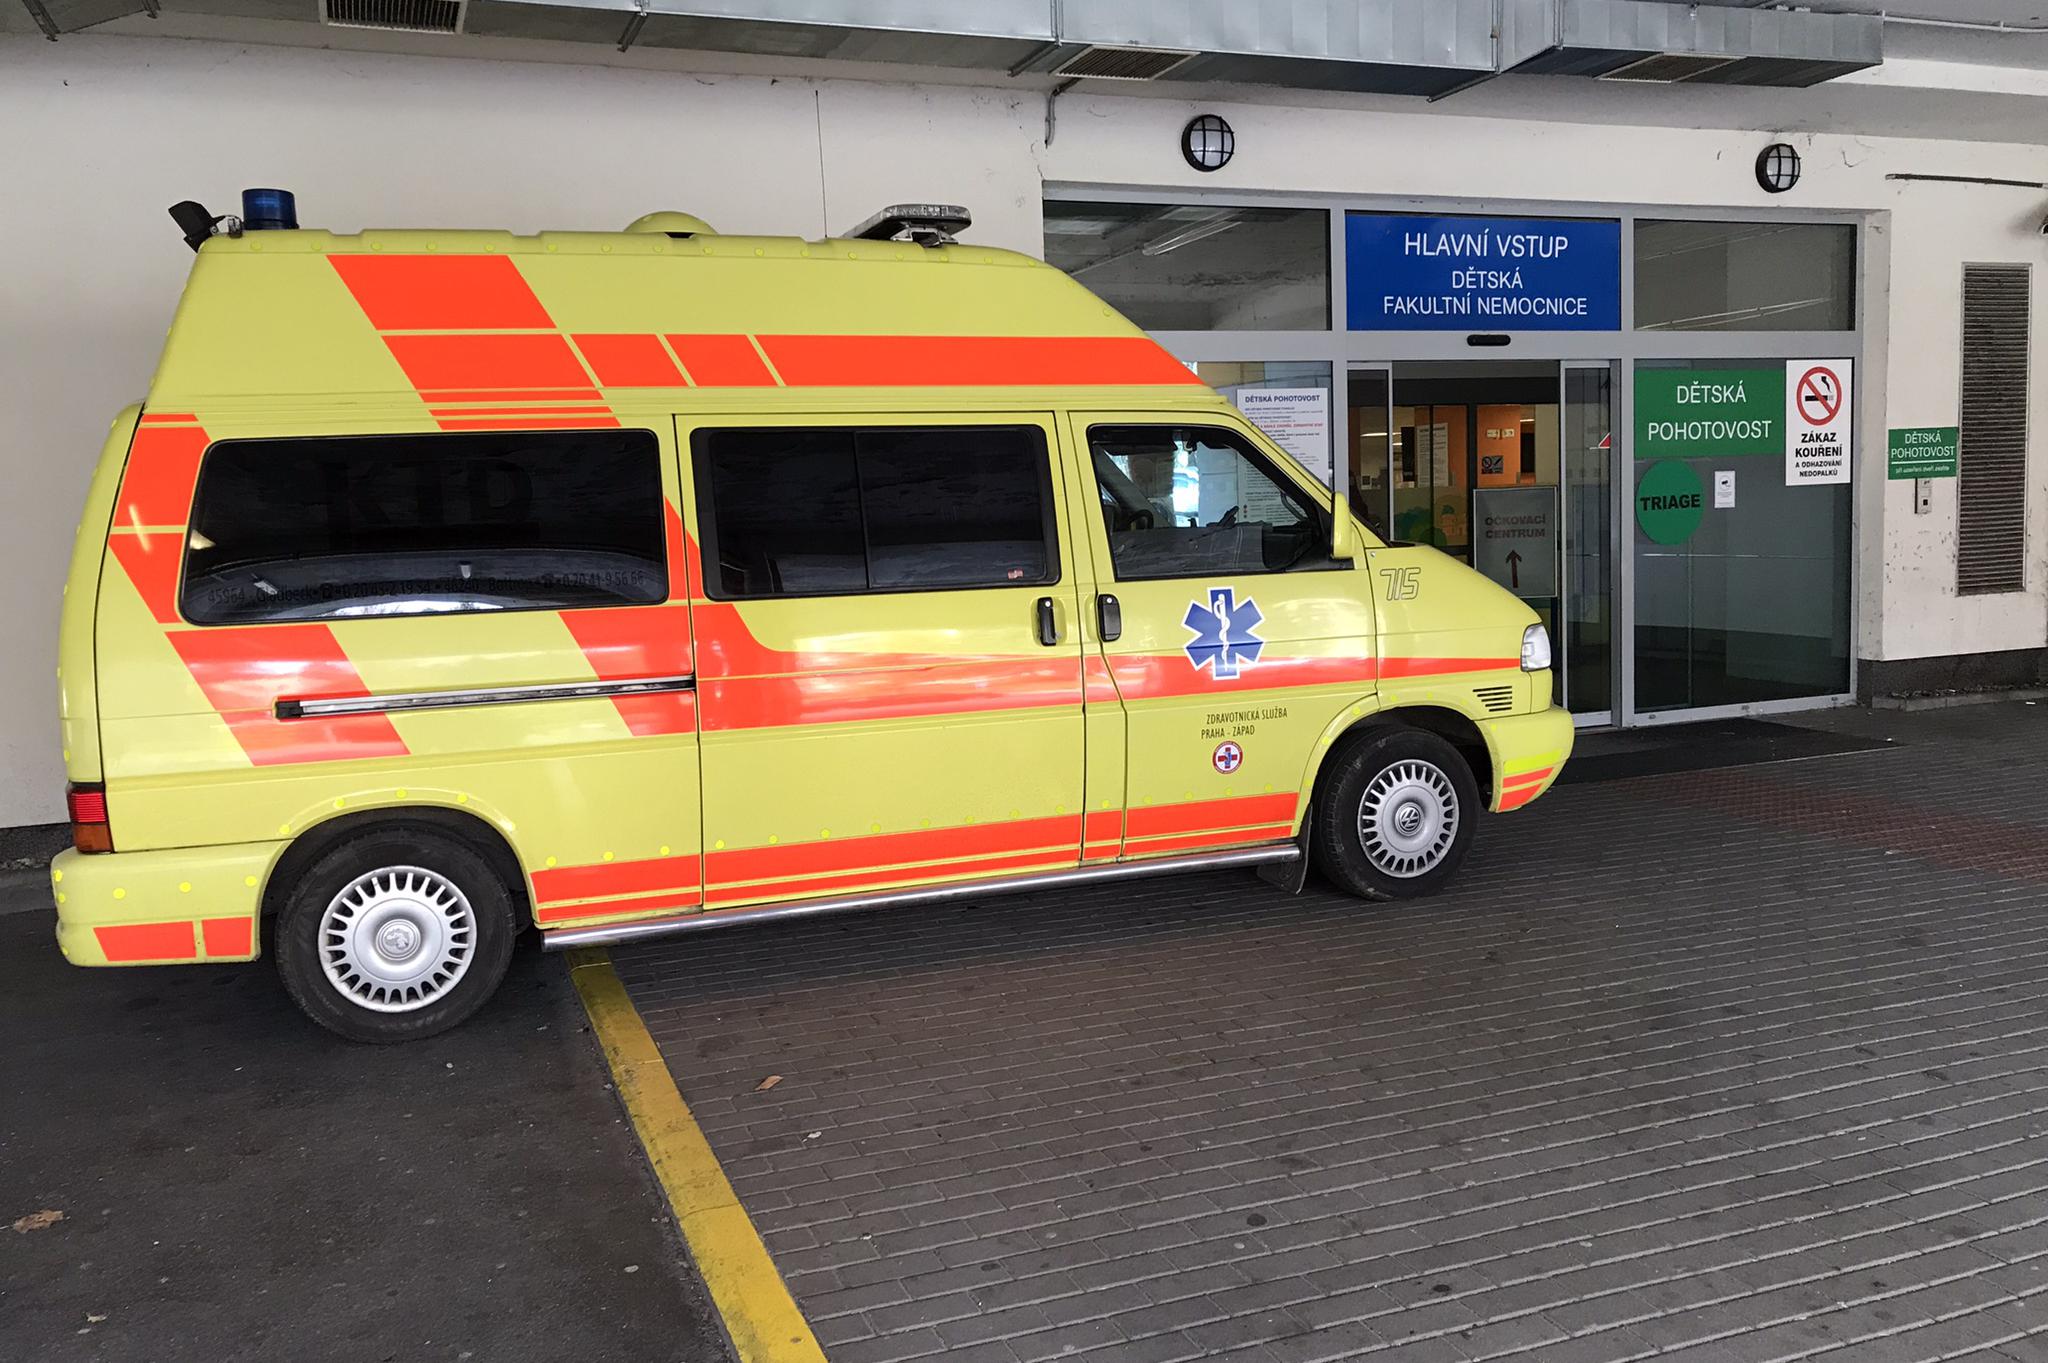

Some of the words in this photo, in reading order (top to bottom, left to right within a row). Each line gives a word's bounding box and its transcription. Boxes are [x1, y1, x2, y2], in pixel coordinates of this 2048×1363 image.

[1405, 228, 1489, 256] HLAVNÍ
[1496, 235, 1568, 258] VSTUP
[1452, 266, 1523, 289] DĚTSKÁ
[1384, 292, 1471, 315] FAKULTNÍ
[1477, 297, 1587, 316] NEMOCNICE
[1245, 394, 1272, 403] DĚTSKÁ
[1677, 380, 1747, 404] DĚTSKÁ
[1648, 420, 1772, 440] POHOTOVOST
[1801, 430, 1837, 443] ZÁKAZ
[1905, 430, 1941, 444] DĚTSKÁ
[1795, 443, 1842, 458] KOUŘENÍ
[1891, 446, 1955, 459] POHOTOVOST
[1801, 459, 1842, 468] ODHAZOVÁNÍ
[1799, 468, 1838, 478] NEDOPALKŮ
[1640, 494, 1700, 511] TRIAGE
[1485, 528, 1546, 539] CENTRUM
[1380, 567, 1421, 601] 715
[1206, 708, 1260, 725] ZDRAVOTNICKÁ
[1261, 705, 1288, 720] SLUŽBA
[1201, 728, 1225, 739] PRAHA
[1232, 723, 1255, 736] ZÁPAD
